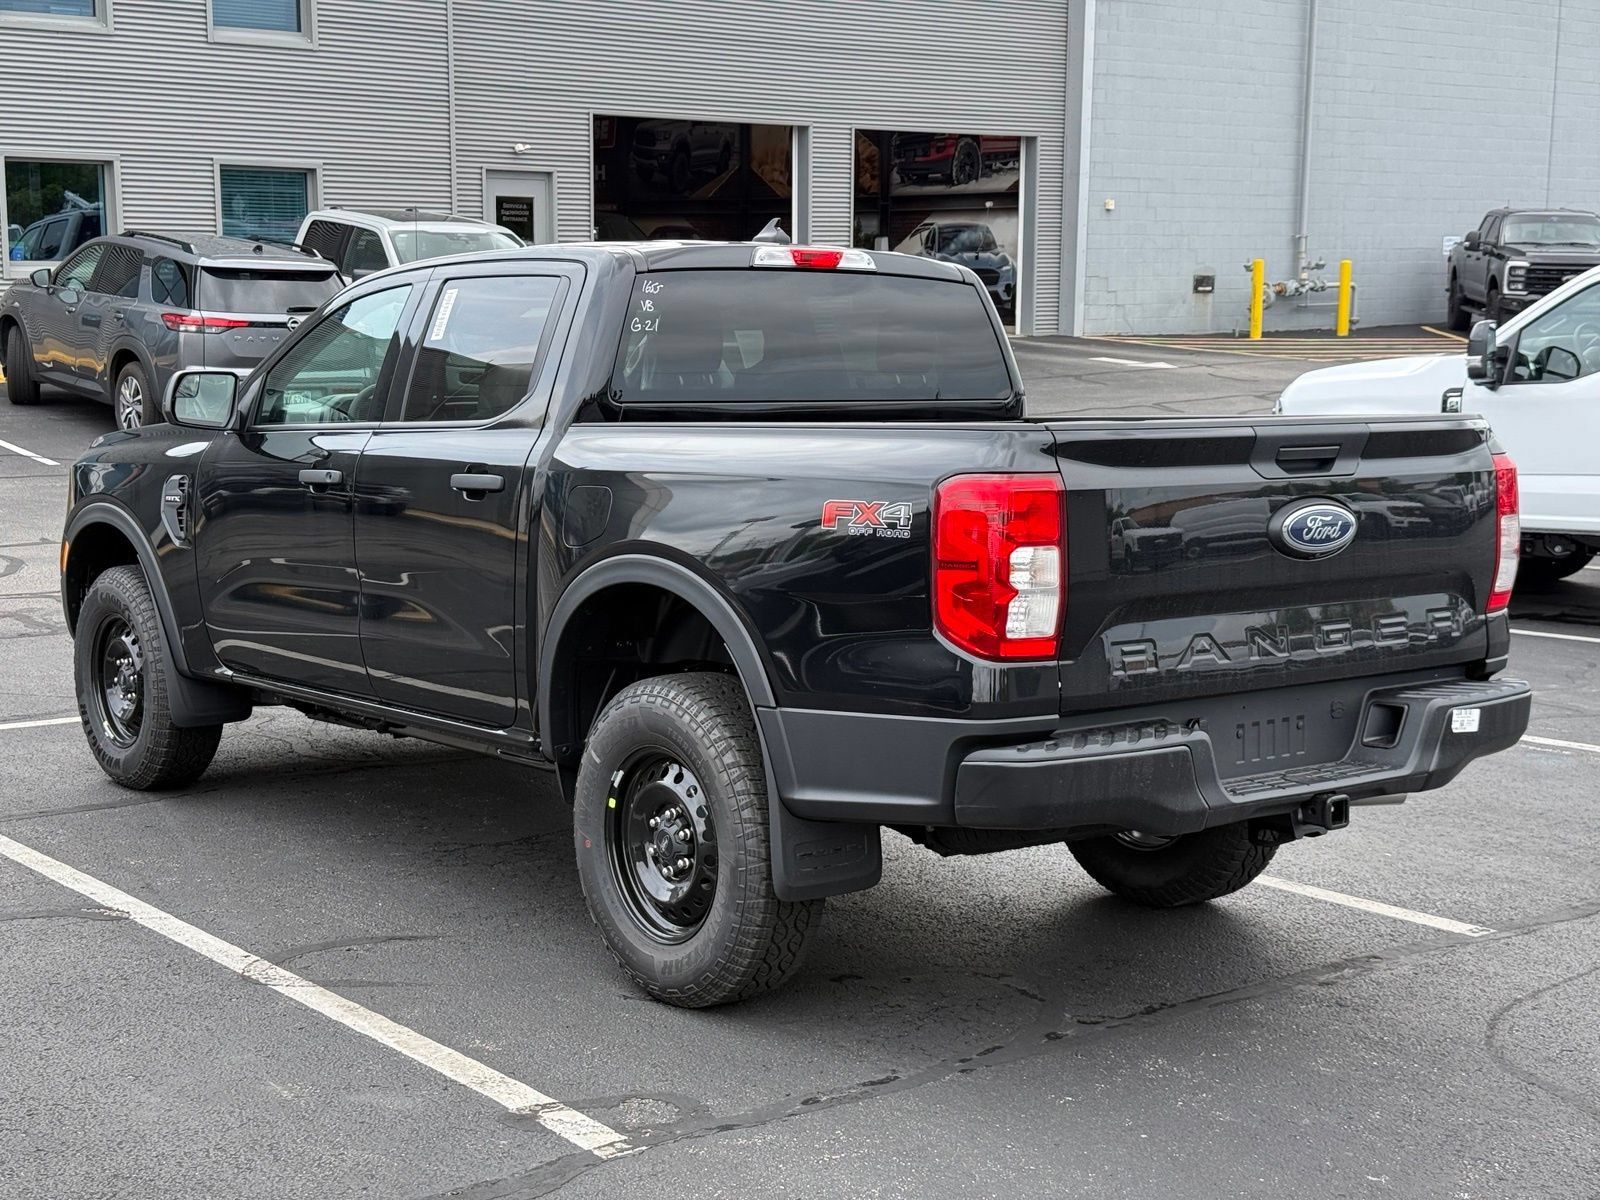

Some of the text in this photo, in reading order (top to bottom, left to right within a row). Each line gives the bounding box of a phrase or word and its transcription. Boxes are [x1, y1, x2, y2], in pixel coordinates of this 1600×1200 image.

[821, 499, 913, 530] FX4
[1302, 515, 1342, 541] Ford
[848, 527, 911, 538] OFF ROAD
[1109, 606, 1460, 678] RANGER
